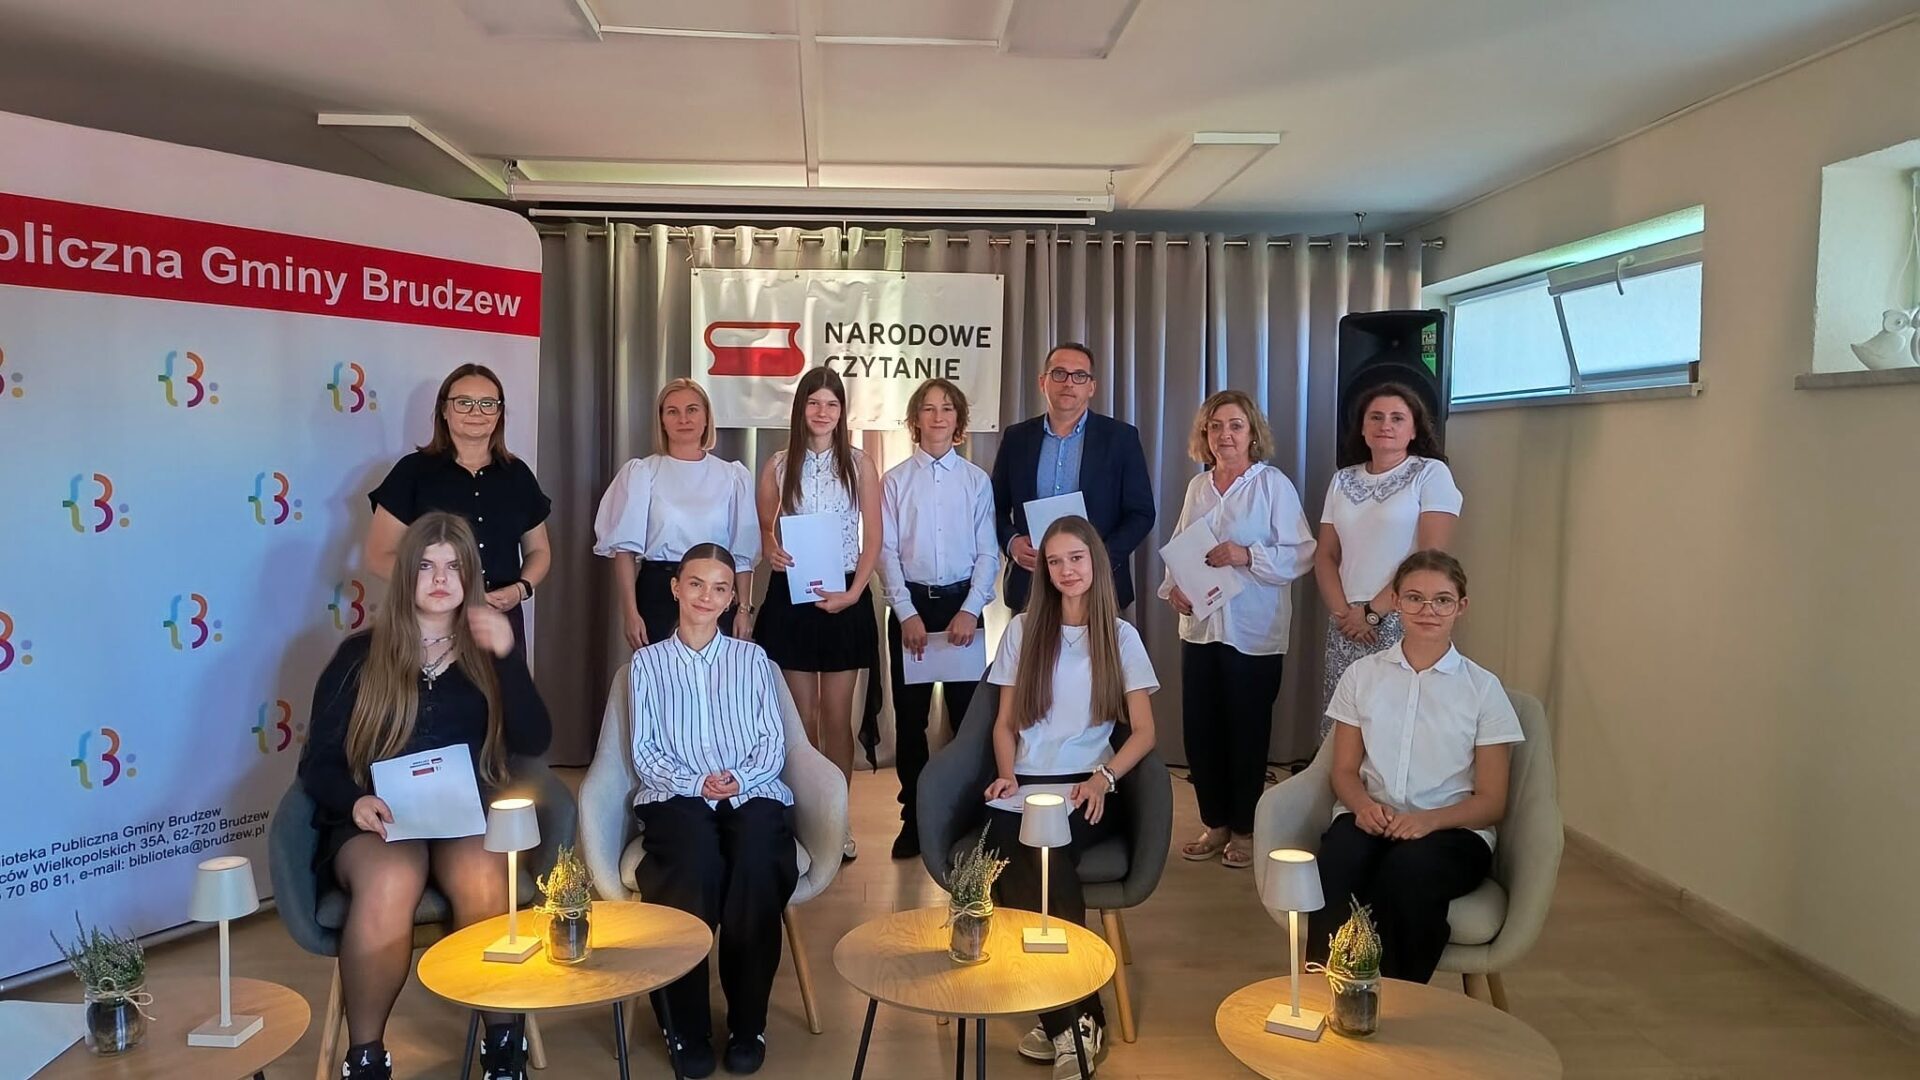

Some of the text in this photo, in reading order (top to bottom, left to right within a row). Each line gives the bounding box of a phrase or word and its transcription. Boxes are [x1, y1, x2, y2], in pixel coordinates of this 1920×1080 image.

[202, 245, 348, 306] Gminy
[362, 266, 522, 317] Brudzew
[825, 321, 992, 348] NARODOWE
[824, 355, 961, 380] CZYTANIE
[33, 842, 136, 875] Wielkopolskich
[140, 834, 169, 849] 35A,
[173, 822, 216, 840] 62-720
[220, 810, 270, 829] Brudzew
[51, 832, 118, 855] Publiczna
[122, 821, 165, 838] Gminy
[168, 808, 221, 827] Brudzew
[6, 824, 265, 899] 70 80 81, e-mail: biblioteka@brudzew.pl
